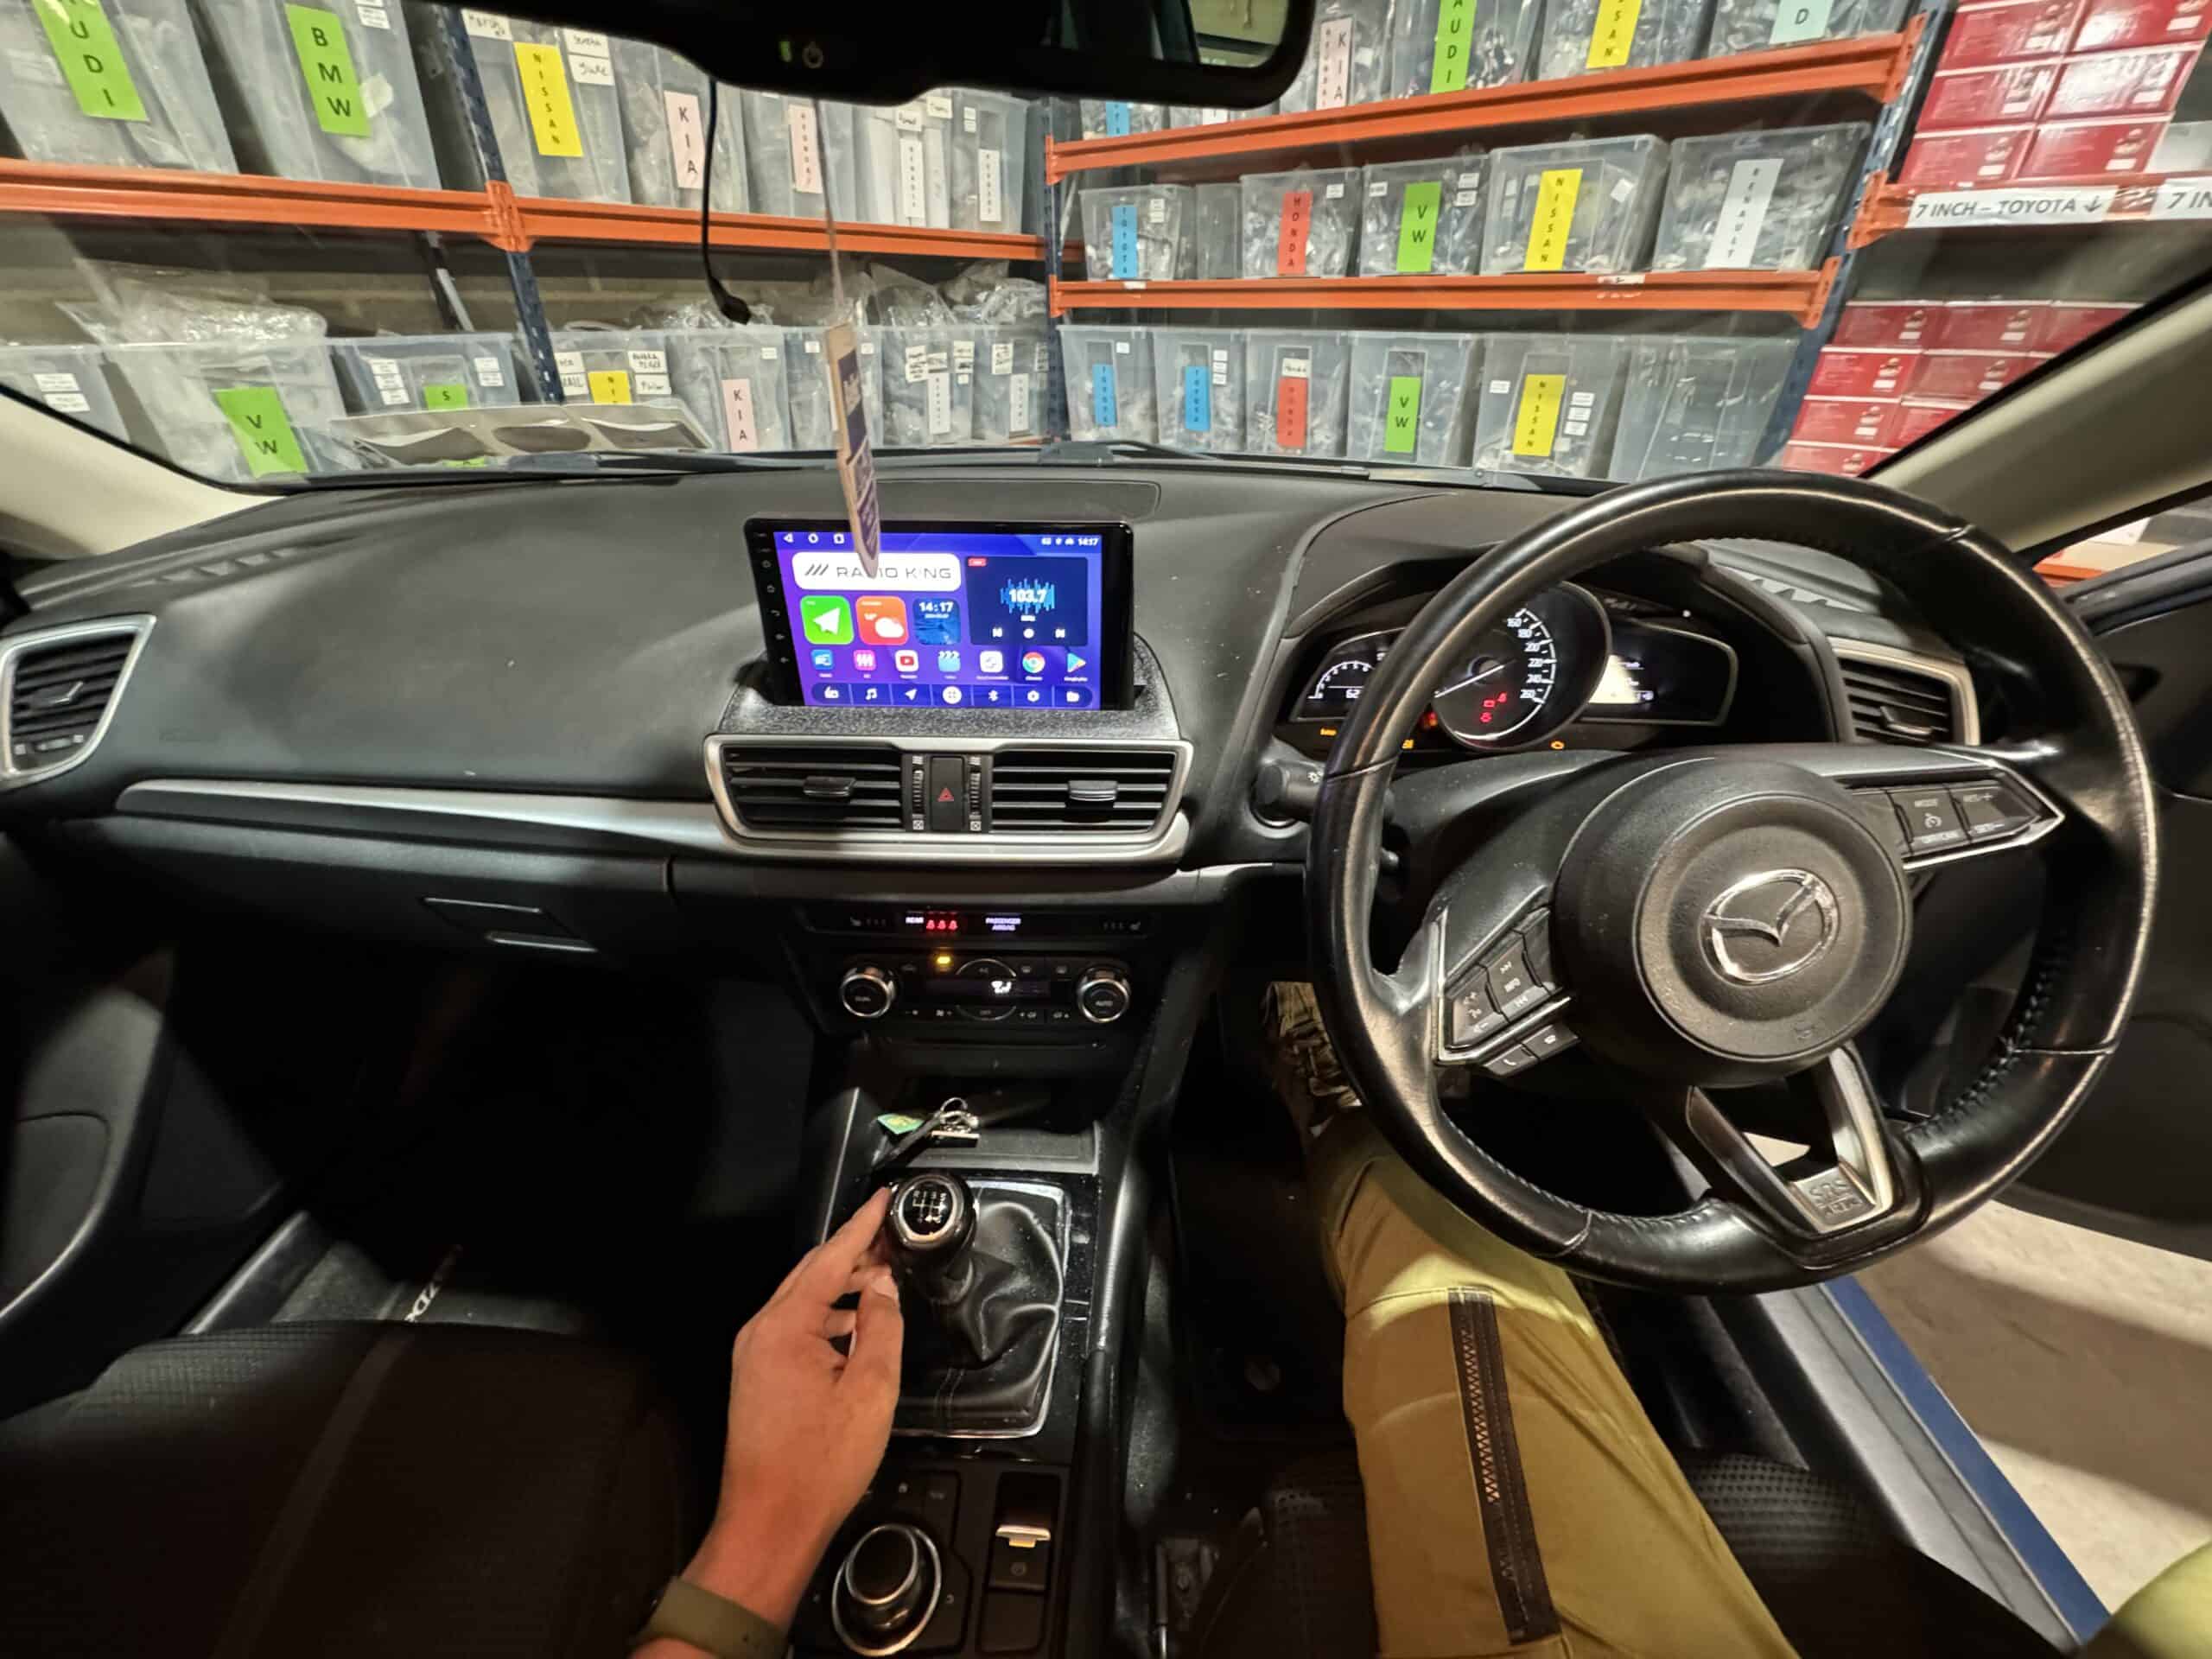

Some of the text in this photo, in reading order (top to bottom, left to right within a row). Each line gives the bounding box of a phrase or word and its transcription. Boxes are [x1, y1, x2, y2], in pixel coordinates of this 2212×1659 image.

[310, 28, 350, 118] BMW
[1334, 31, 1347, 100] KIA
[531, 54, 560, 144] NISSAN
[677, 105, 698, 175] KIA
[1540, 176, 1565, 263] NISSAN
[1916, 203, 1926, 218] 7
[1929, 201, 1975, 217] INCH
[1998, 198, 2075, 215] TOYOTA
[2165, 192, 2186, 209] 7
[1287, 197, 1300, 267] HONDA
[1412, 204, 1427, 244] VW
[733, 389, 747, 441] KIA
[1395, 396, 1409, 429] VW
[1526, 380, 1547, 448] NISSAN
[245, 414, 278, 454] VW
[836, 566, 899, 578] RAIO
[918, 601, 954, 613] 14:17
[1008, 589, 1047, 603] 103.7
[1524, 642, 1540, 652] 200
